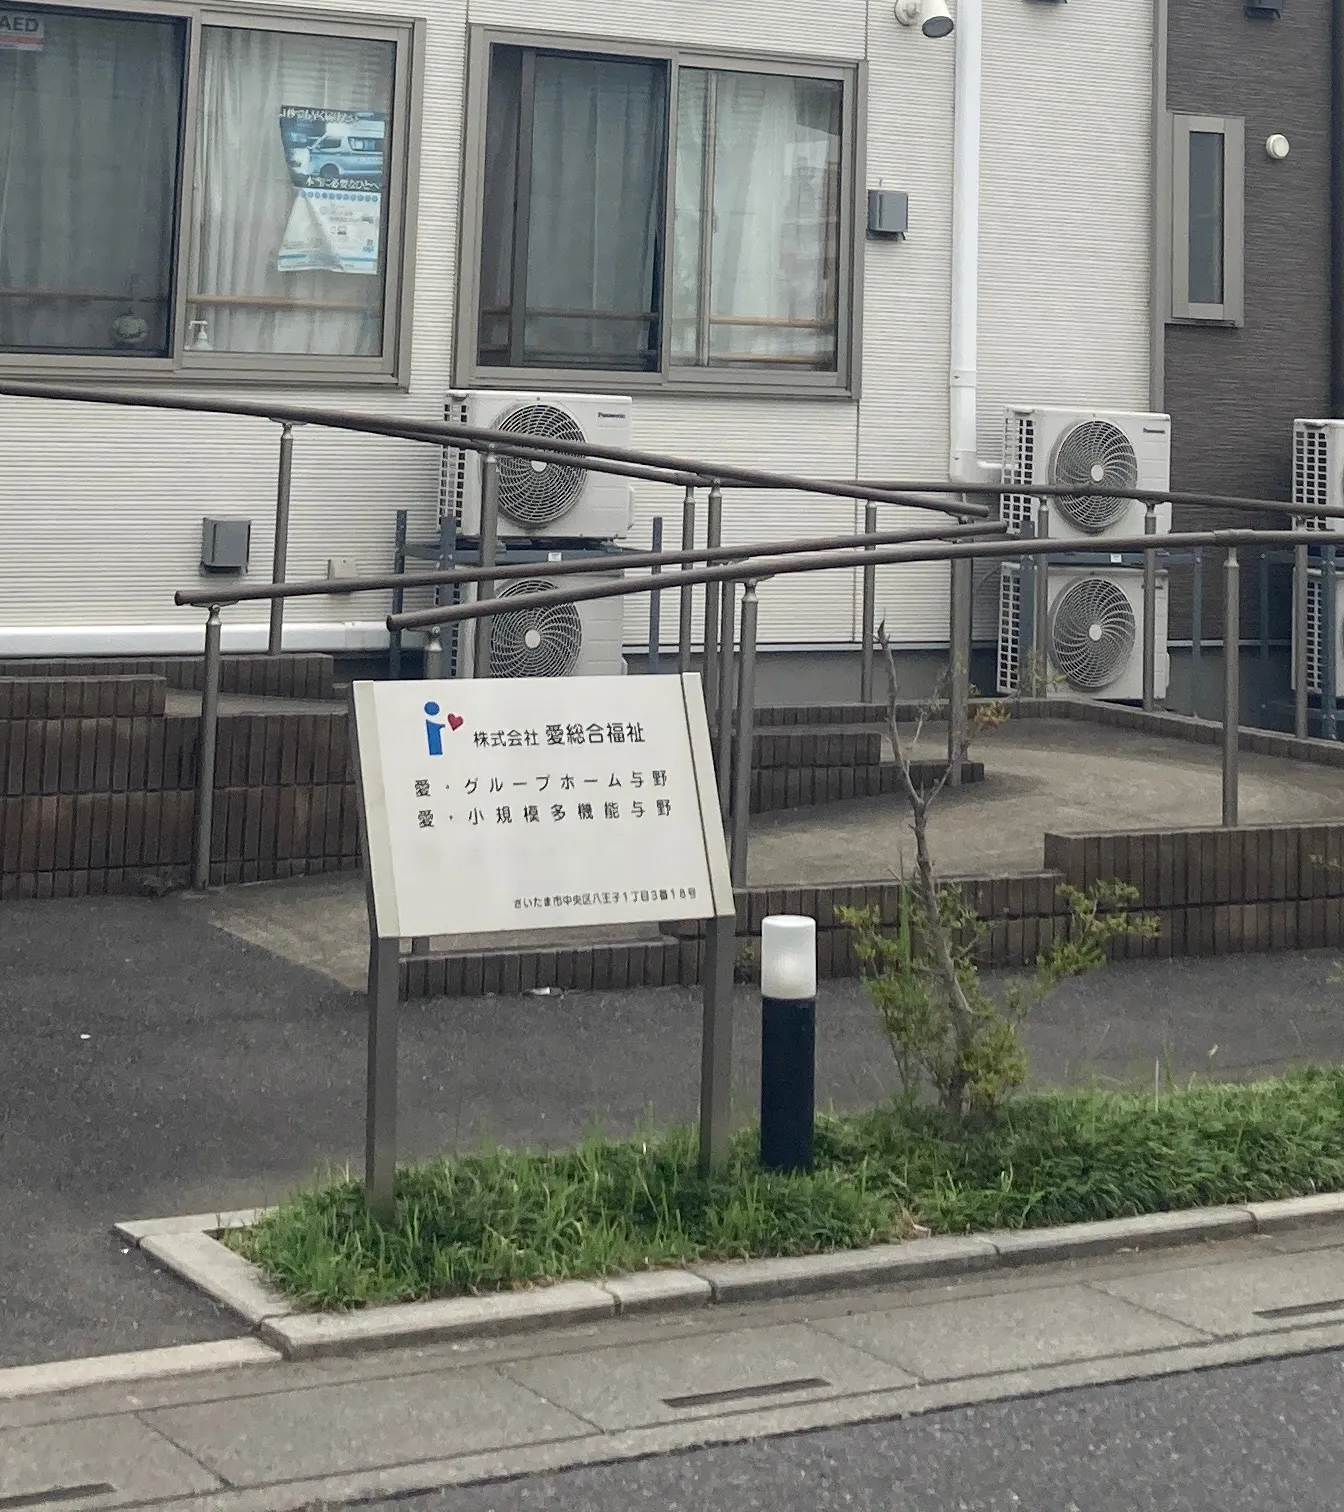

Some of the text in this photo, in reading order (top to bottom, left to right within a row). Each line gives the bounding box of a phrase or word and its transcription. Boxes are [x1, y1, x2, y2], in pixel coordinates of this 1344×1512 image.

[473, 722, 645, 748] 株式会社 愛総合福祉
[414, 769, 668, 798] 愛・グループホーム与野
[418, 799, 672, 829] 愛・小規模多機能与野
